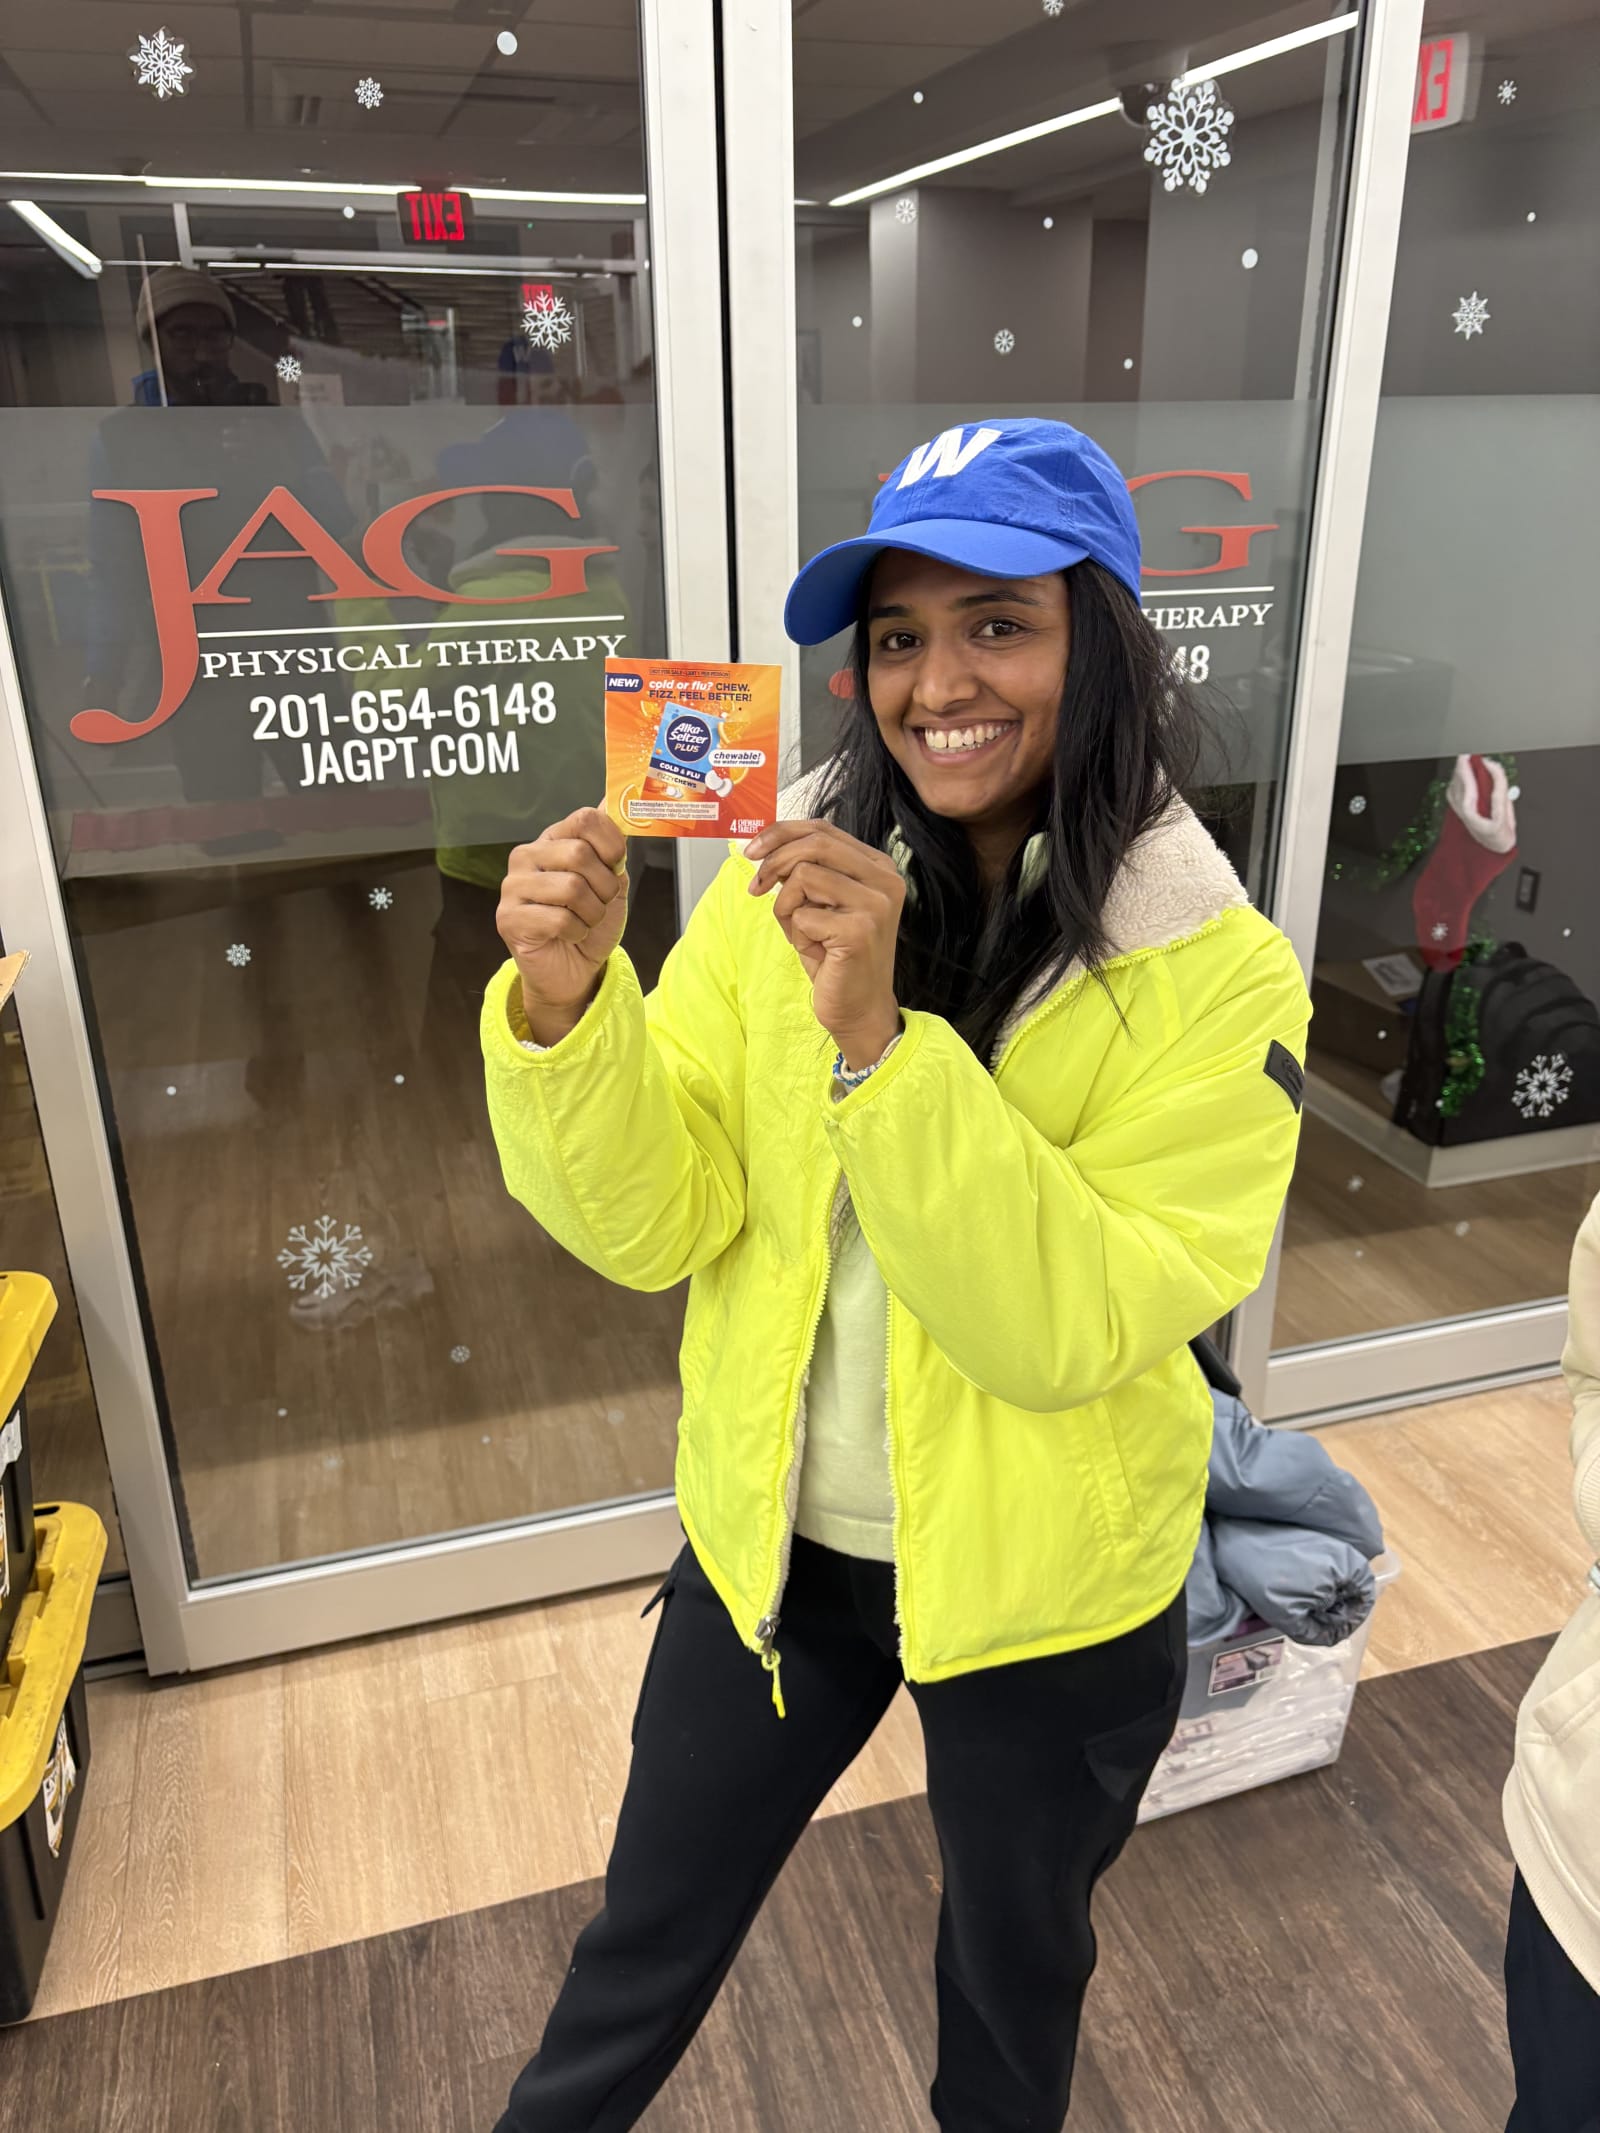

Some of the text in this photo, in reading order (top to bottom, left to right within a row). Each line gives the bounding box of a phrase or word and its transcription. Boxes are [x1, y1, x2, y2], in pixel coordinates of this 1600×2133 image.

[896, 427, 1003, 491] W
[70, 485, 619, 744] JAG
[1141, 603, 1273, 630] HERAPY
[202, 634, 626, 679] PHYSICAL THERAPY
[608, 677, 640, 688] NEW!
[648, 679, 751, 692] cold or flu? CHEW.
[649, 690, 752, 702] FIZZ. FEEL BETTER!
[250, 681, 557, 740] 201-654-6148
[673, 722, 704, 734] Alka-
[668, 730, 709, 744] Seltzer
[674, 742, 701, 752] PLUS
[300, 730, 520, 787] JAGPT.COM
[714, 752, 761, 760] chewable!
[659, 762, 680, 773] COLD
[686, 770, 701, 779] FLU
[729, 819, 737, 833] 4
